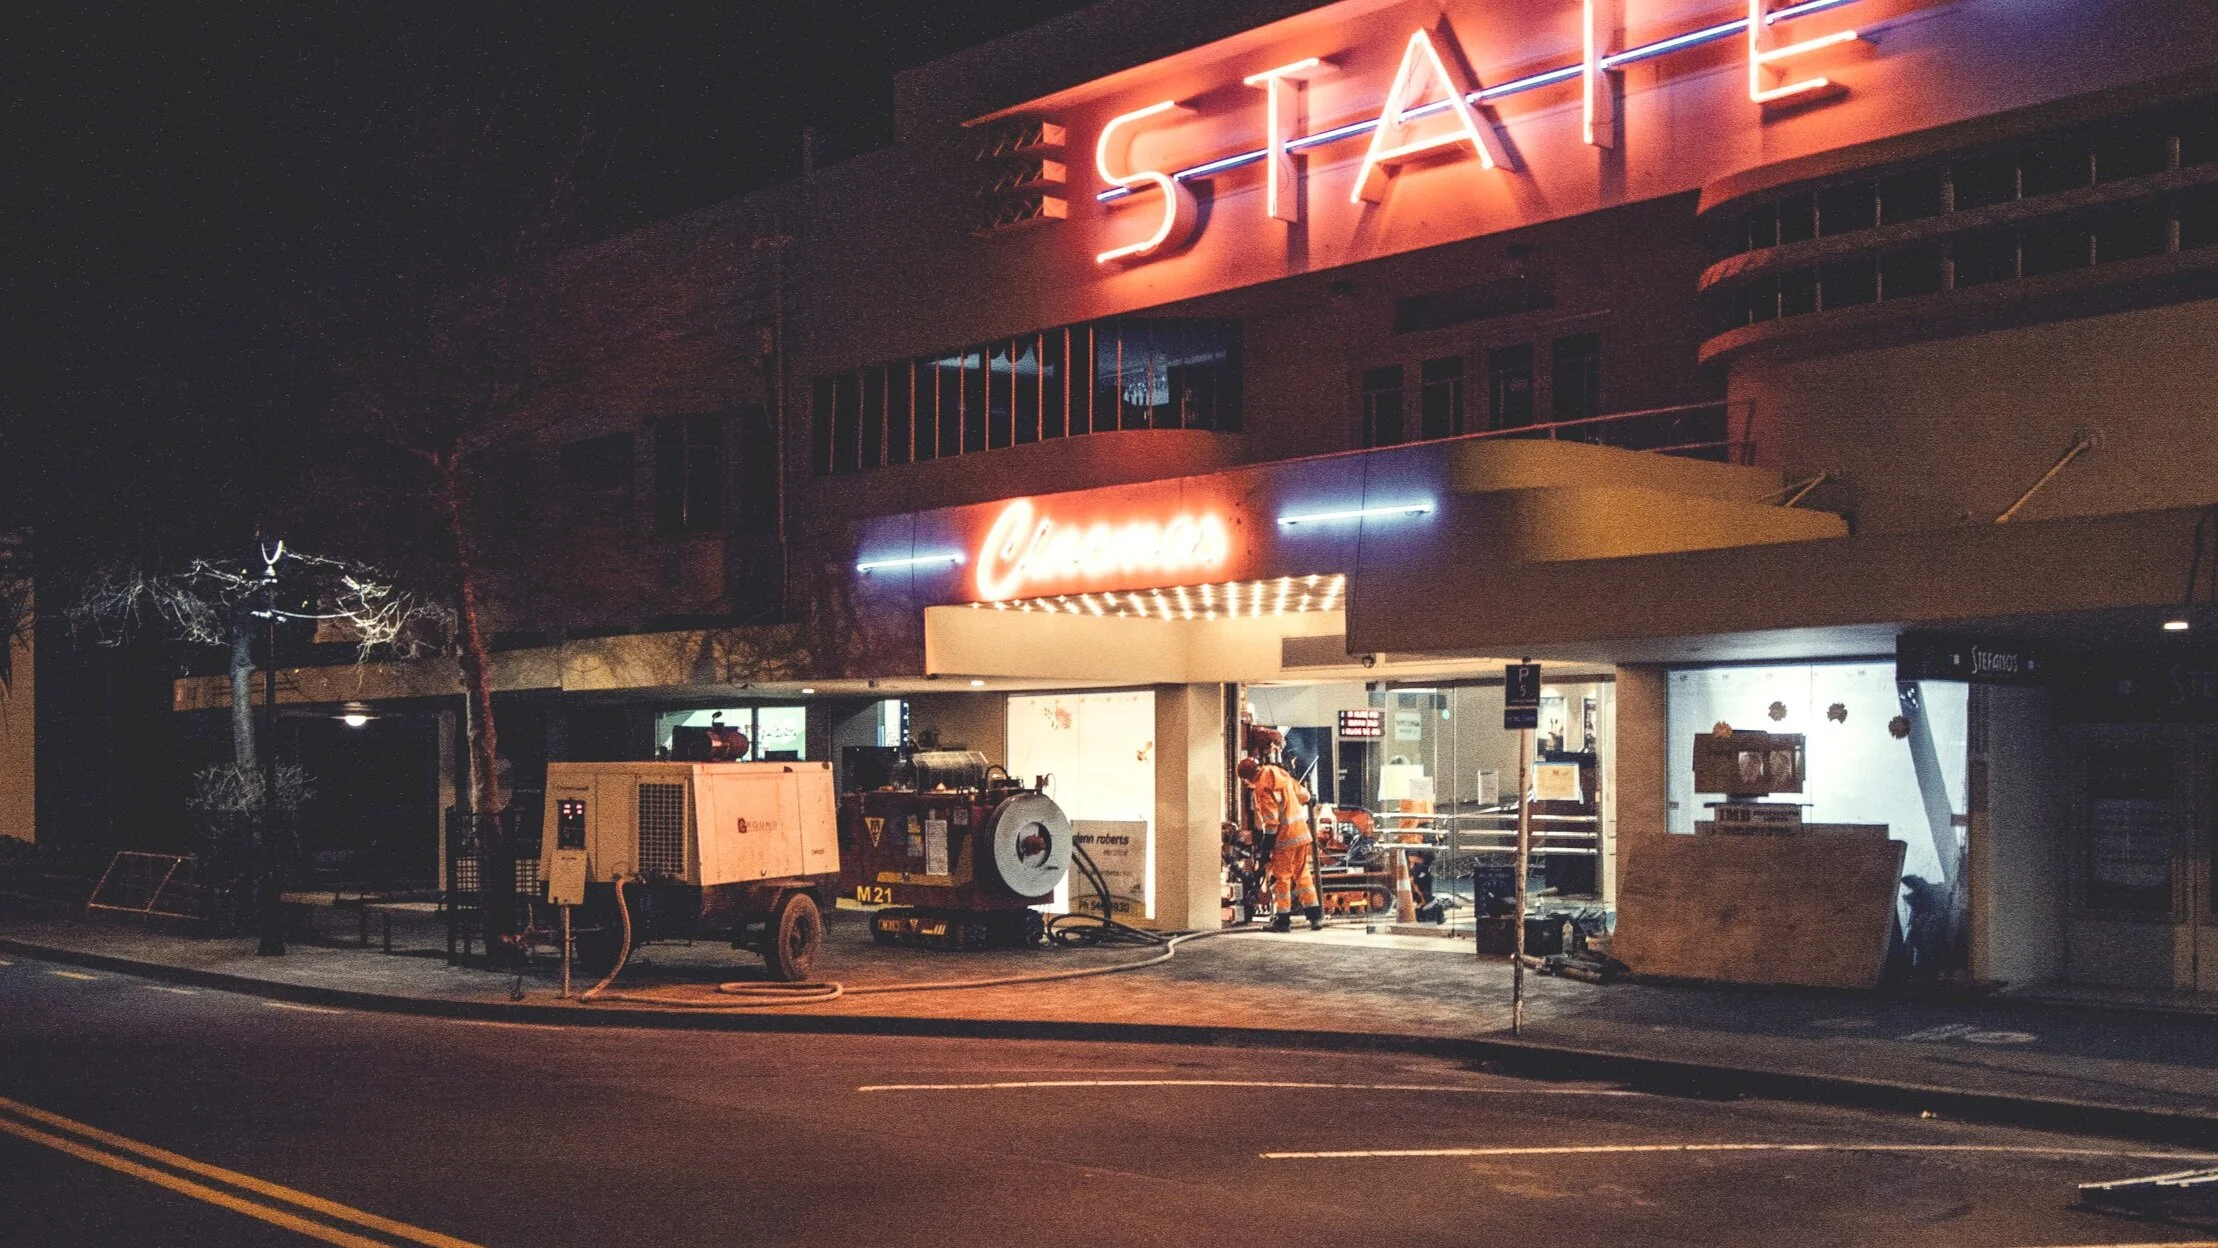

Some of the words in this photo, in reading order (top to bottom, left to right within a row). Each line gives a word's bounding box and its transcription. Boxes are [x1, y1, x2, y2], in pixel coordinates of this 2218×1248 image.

[976, 499, 1229, 600] Cinemas
[1518, 667, 1530, 684] P
[1095, 832, 1129, 846] roberts
